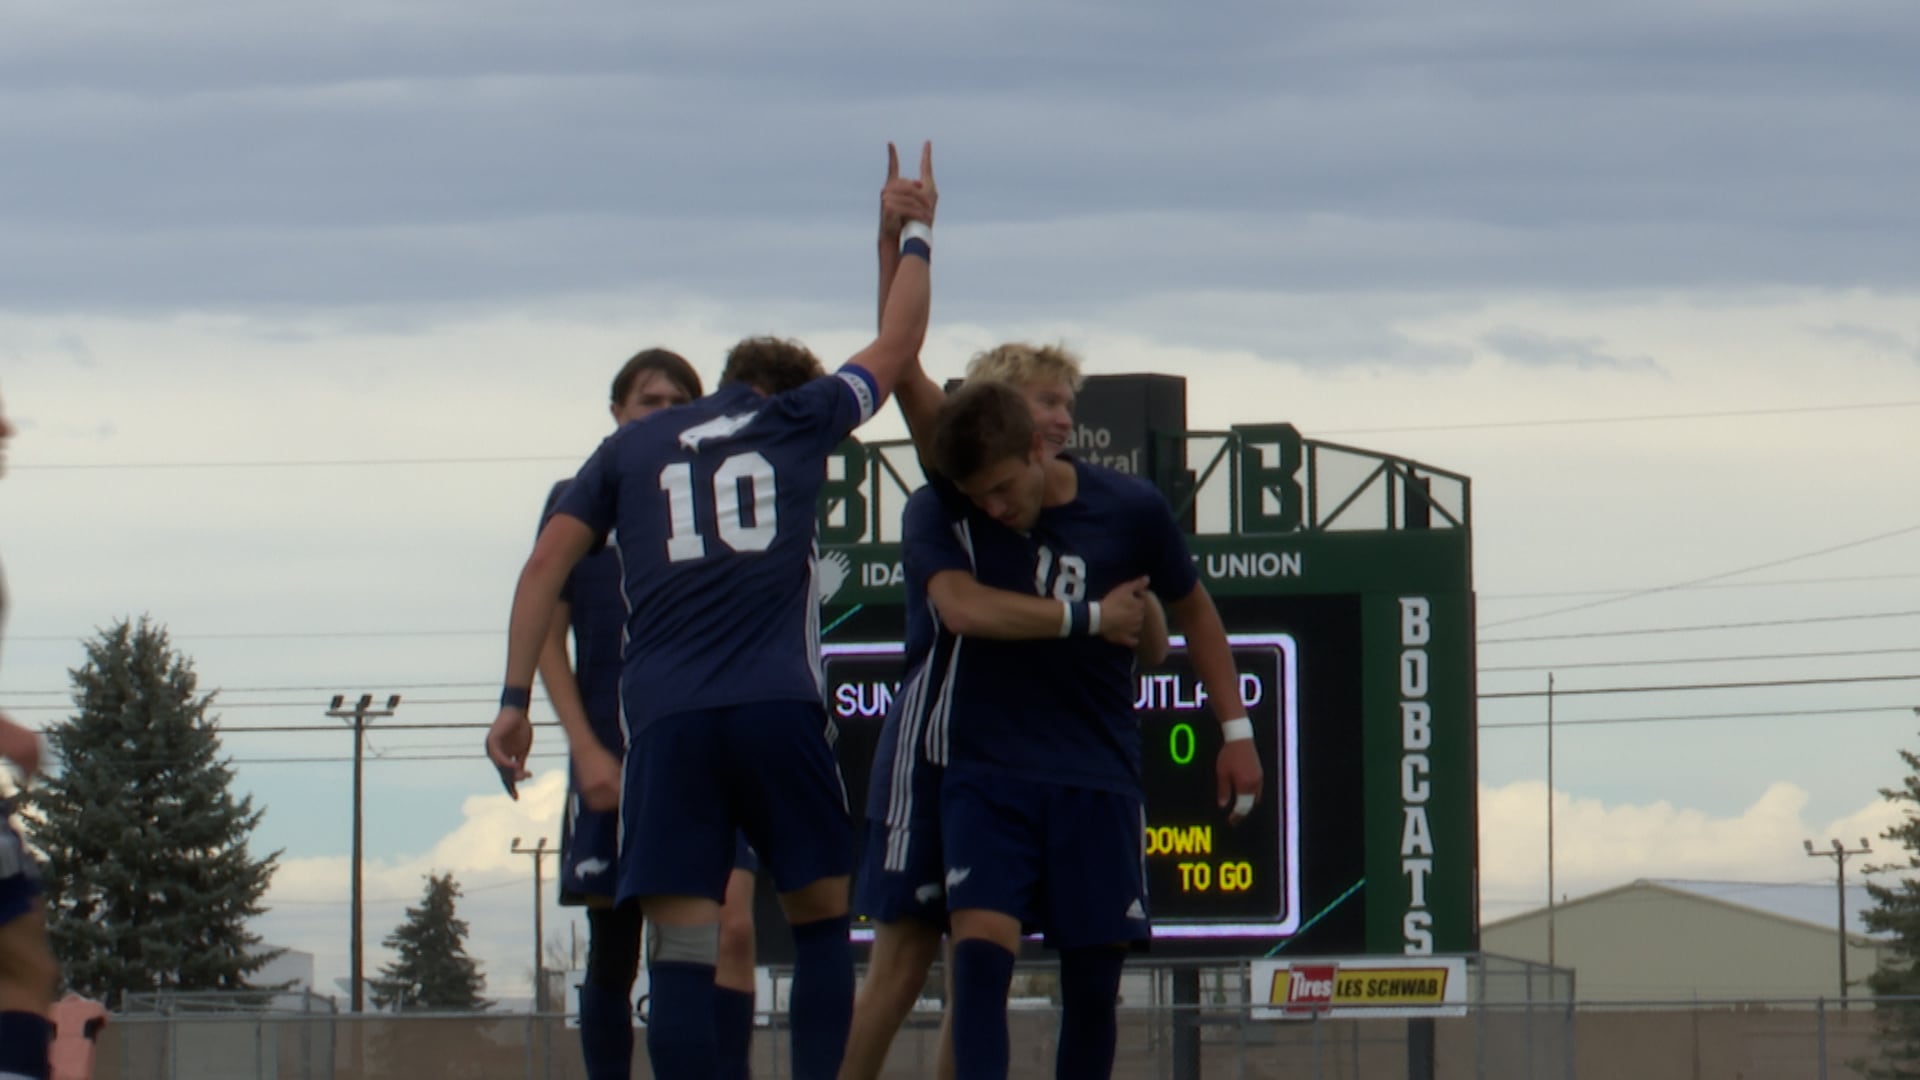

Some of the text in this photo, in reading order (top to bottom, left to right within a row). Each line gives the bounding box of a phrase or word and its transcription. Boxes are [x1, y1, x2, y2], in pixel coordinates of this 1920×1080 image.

[1232, 422, 1303, 533] B
[659, 451, 778, 563] 10
[1033, 545, 1087, 602] 18
[1206, 551, 1302, 580] UNION
[1132, 673, 1262, 709] UITLD
[1169, 722, 1196, 765] 0
[1400, 597, 1434, 955] BOBCATS
[1145, 825, 1212, 855] DOWN
[1177, 861, 1253, 892] TO GO
[1291, 970, 1438, 1002] Tires LES SCHWAB
